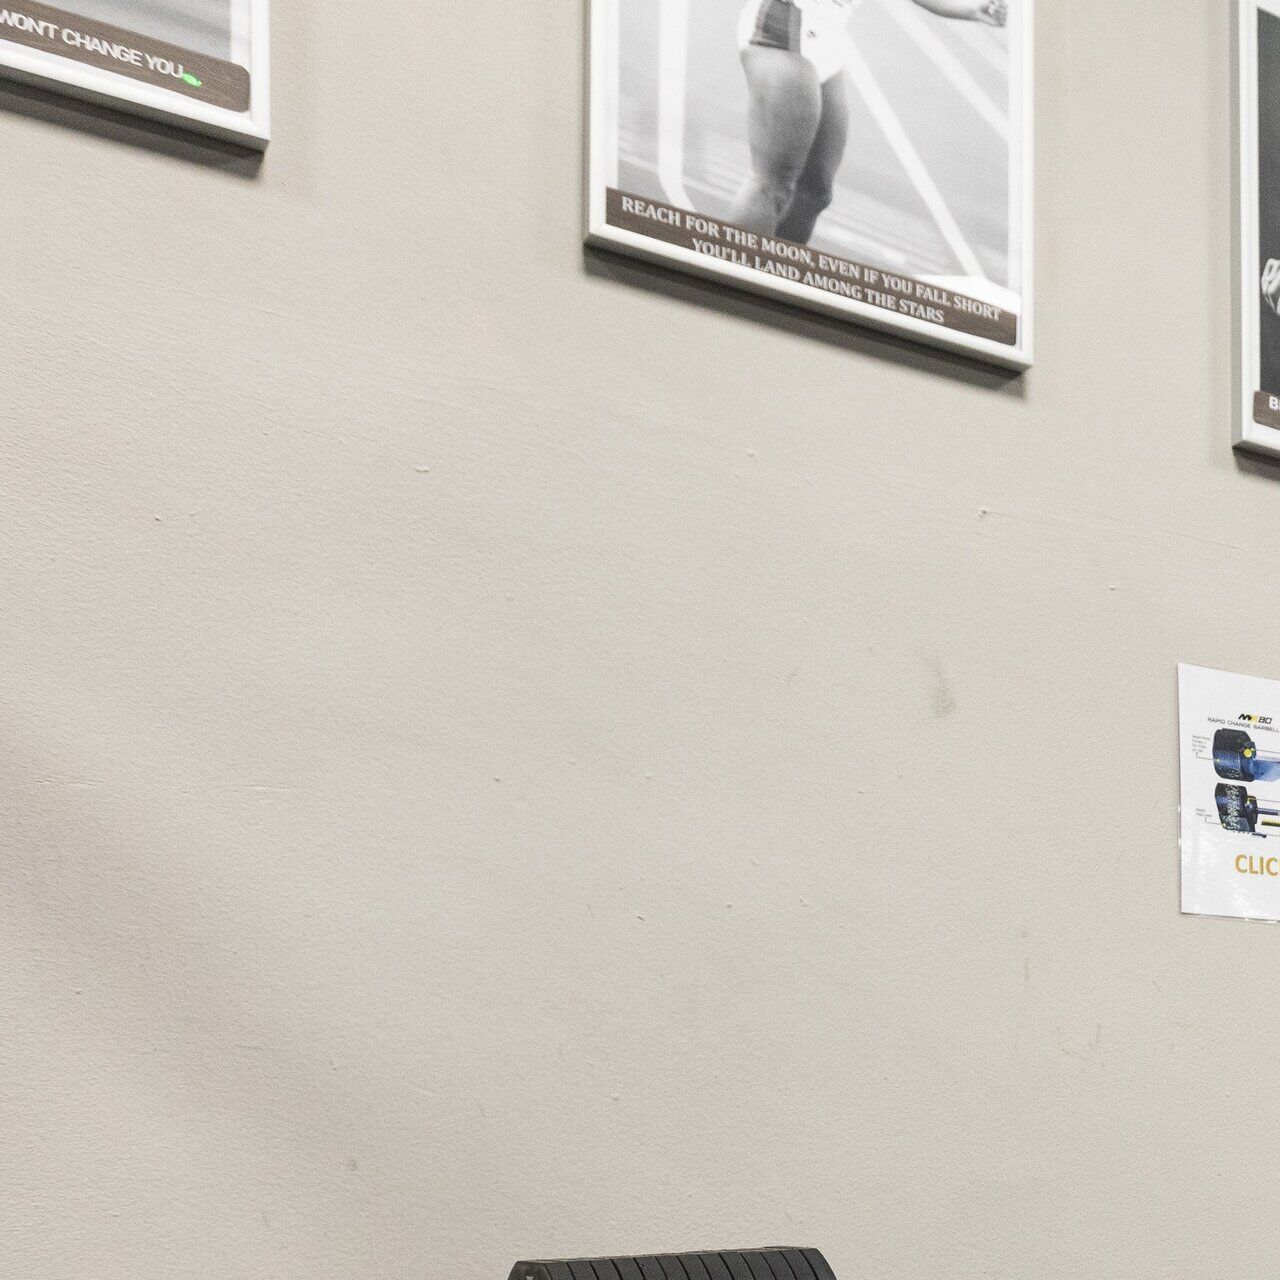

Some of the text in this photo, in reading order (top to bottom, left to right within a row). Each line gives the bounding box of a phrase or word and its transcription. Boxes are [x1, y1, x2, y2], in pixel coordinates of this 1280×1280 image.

[61, 28, 143, 67] CHANGE
[144, 54, 184, 79] YOU
[622, 196, 1001, 321] REACH FOR THE MOON, EVEN IF YOU FALL SHORT
[692, 237, 945, 323] YOU'LL LAND AMONG THE STARS
[1207, 716, 1225, 725] RAPID
[1227, 719, 1251, 729] CHANGE
[1253, 725, 1280, 734] BARBELL
